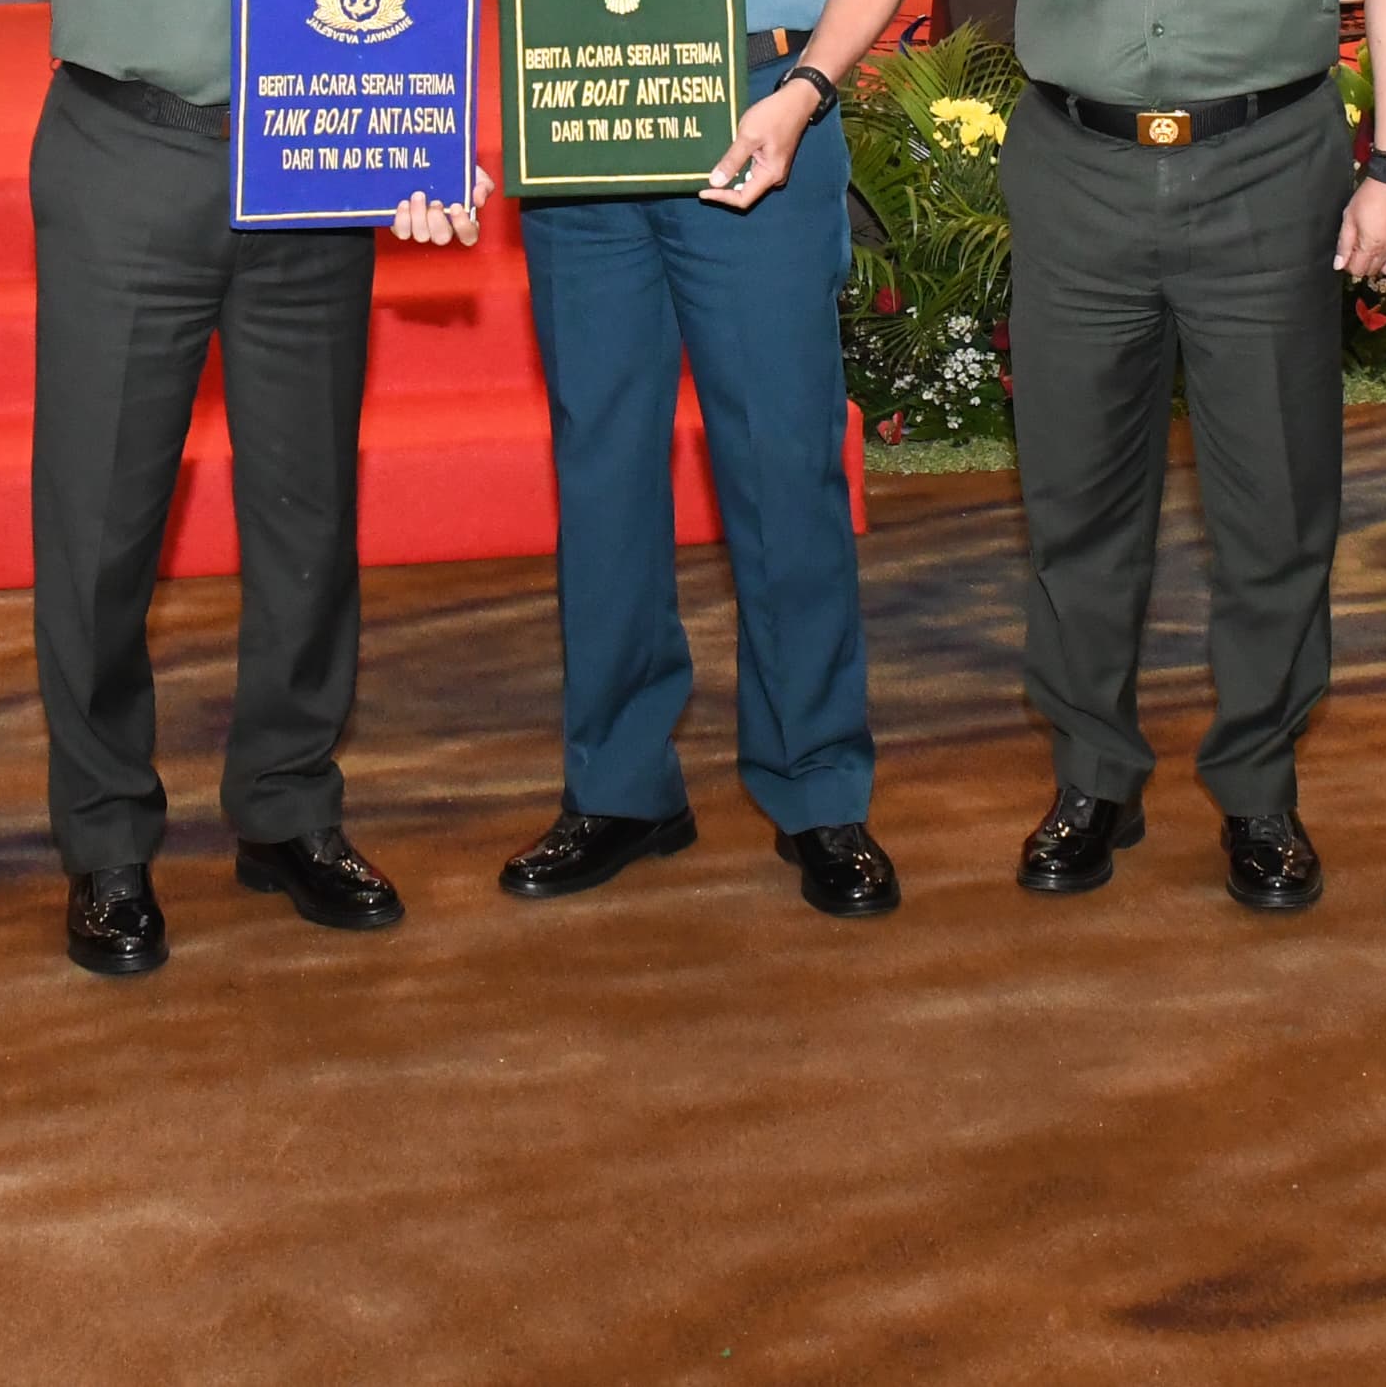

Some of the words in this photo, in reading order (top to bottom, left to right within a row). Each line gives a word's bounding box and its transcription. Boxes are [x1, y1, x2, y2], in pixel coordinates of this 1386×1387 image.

[305, 17, 359, 45] JALESVEVA
[363, 16, 414, 44] JAYAMAHE
[524, 46, 572, 70] BERITA
[576, 45, 623, 68] ACARA
[627, 43, 670, 67] SERAH
[673, 42, 723, 66] TERIMA
[258, 74, 304, 97] BERITA
[309, 73, 357, 96] ACARA
[361, 73, 404, 96] SERAH
[408, 73, 455, 96] TERIMA
[531, 80, 579, 109] TANK
[581, 78, 630, 107] BOAT
[636, 76, 726, 106] ANTASENA
[263, 109, 311, 136] TANK
[313, 108, 363, 135] BOAT
[367, 107, 456, 135] ANTASENA
[551, 119, 584, 142] DARI
[587, 118, 608, 141] TNI
[613, 118, 632, 140] AD
[635, 117, 654, 140] KE
[658, 116, 679, 139] TNI
[683, 116, 702, 138] AL
[282, 148, 314, 170] DARI
[318, 148, 339, 170] TNI
[342, 148, 362, 169] AD
[366, 147, 383, 169] KE
[388, 147, 408, 169] TNI
[412, 147, 430, 168] AL
